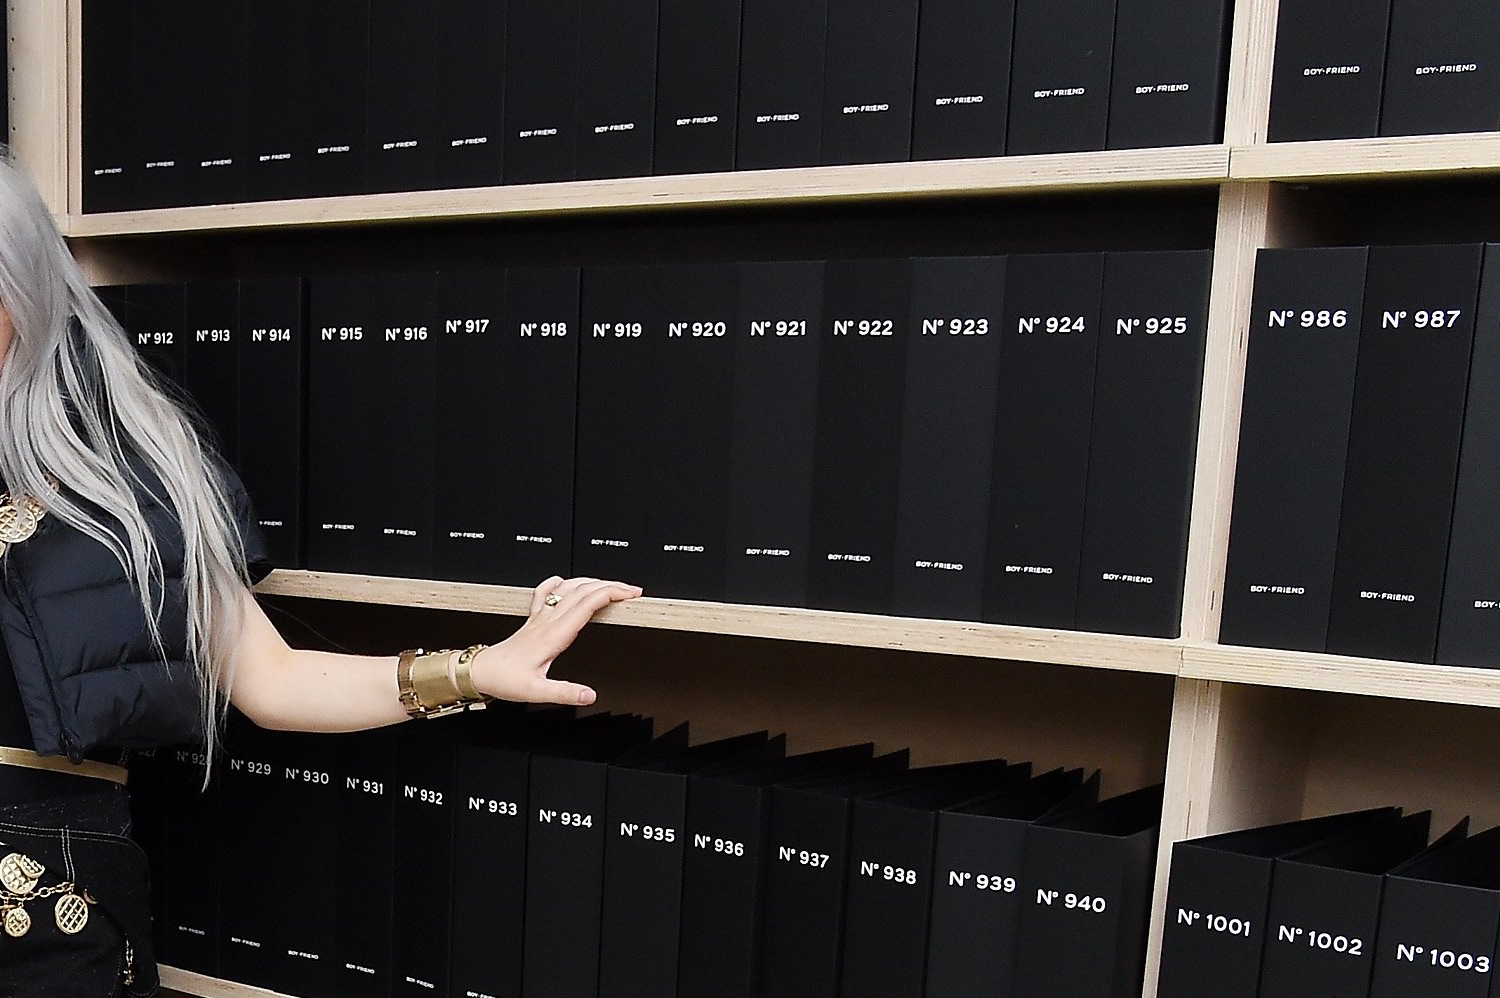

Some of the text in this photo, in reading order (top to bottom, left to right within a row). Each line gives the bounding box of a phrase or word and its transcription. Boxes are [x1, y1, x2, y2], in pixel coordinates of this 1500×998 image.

[465, 319, 490, 334] 917
[775, 320, 806, 336] 921
[858, 319, 893, 336] 922
[949, 318, 989, 335] 923
[1046, 316, 1085, 334] 924
[1145, 316, 1187, 335] 925
[1300, 310, 1347, 328] 986
[1414, 309, 1461, 329] 987
[268, 328, 291, 342] 914
[614, 322, 642, 338] 919
[691, 321, 727, 337] 920
[303, 770, 329, 785] 930
[488, 799, 518, 816] 933
[642, 825, 675, 843] 935
[799, 850, 830, 869] 937
[883, 865, 917, 885] 938
[976, 874, 1016, 893] 939
[1064, 893, 1106, 913] 940
[1206, 913, 1251, 937] 1001
[1308, 930, 1363, 956] 1002
[1430, 949, 1490, 973] 1003
